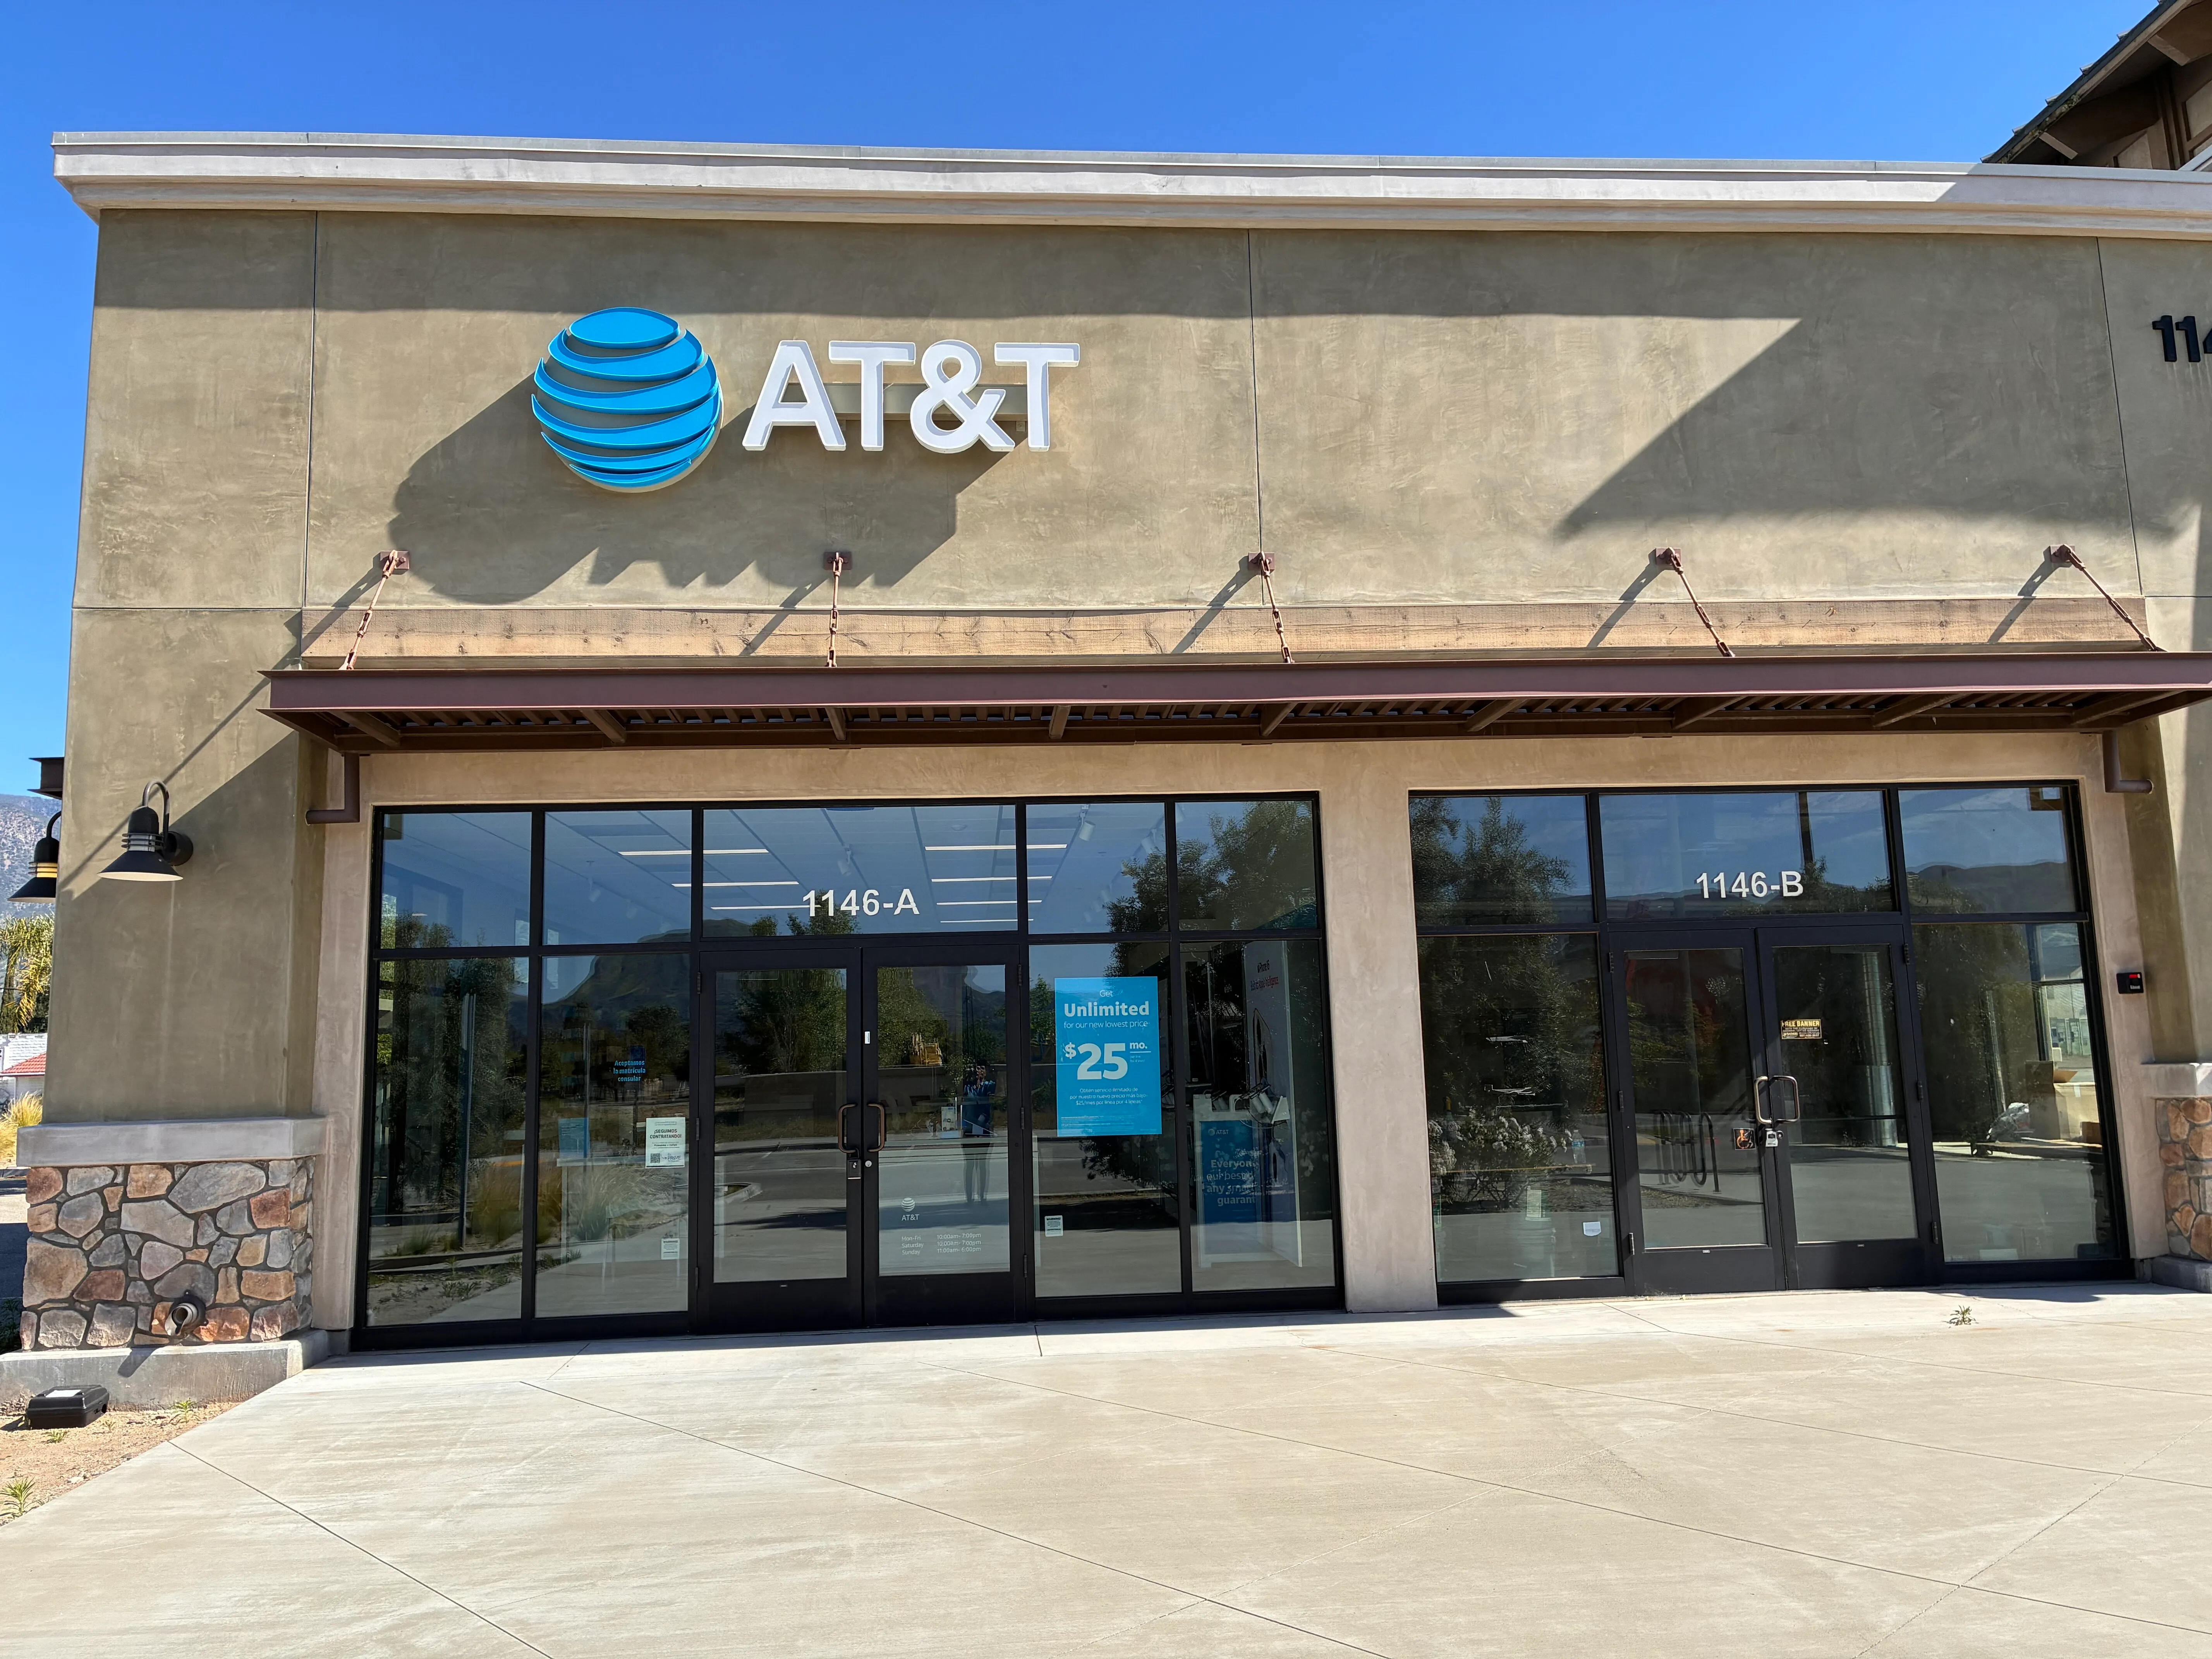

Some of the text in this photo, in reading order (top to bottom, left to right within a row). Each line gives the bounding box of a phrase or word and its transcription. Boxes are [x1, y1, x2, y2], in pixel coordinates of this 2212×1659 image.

[742, 339, 1080, 453] AT&T
[1696, 871, 1803, 898] 1146-B
[803, 888, 920, 917] 1146-A
[1064, 1001, 1149, 1017] Unlimited
[1211, 1159, 1252, 1170] Everyon
[1207, 1185, 1225, 1194] any
[1217, 1196, 1256, 1206] guarant
